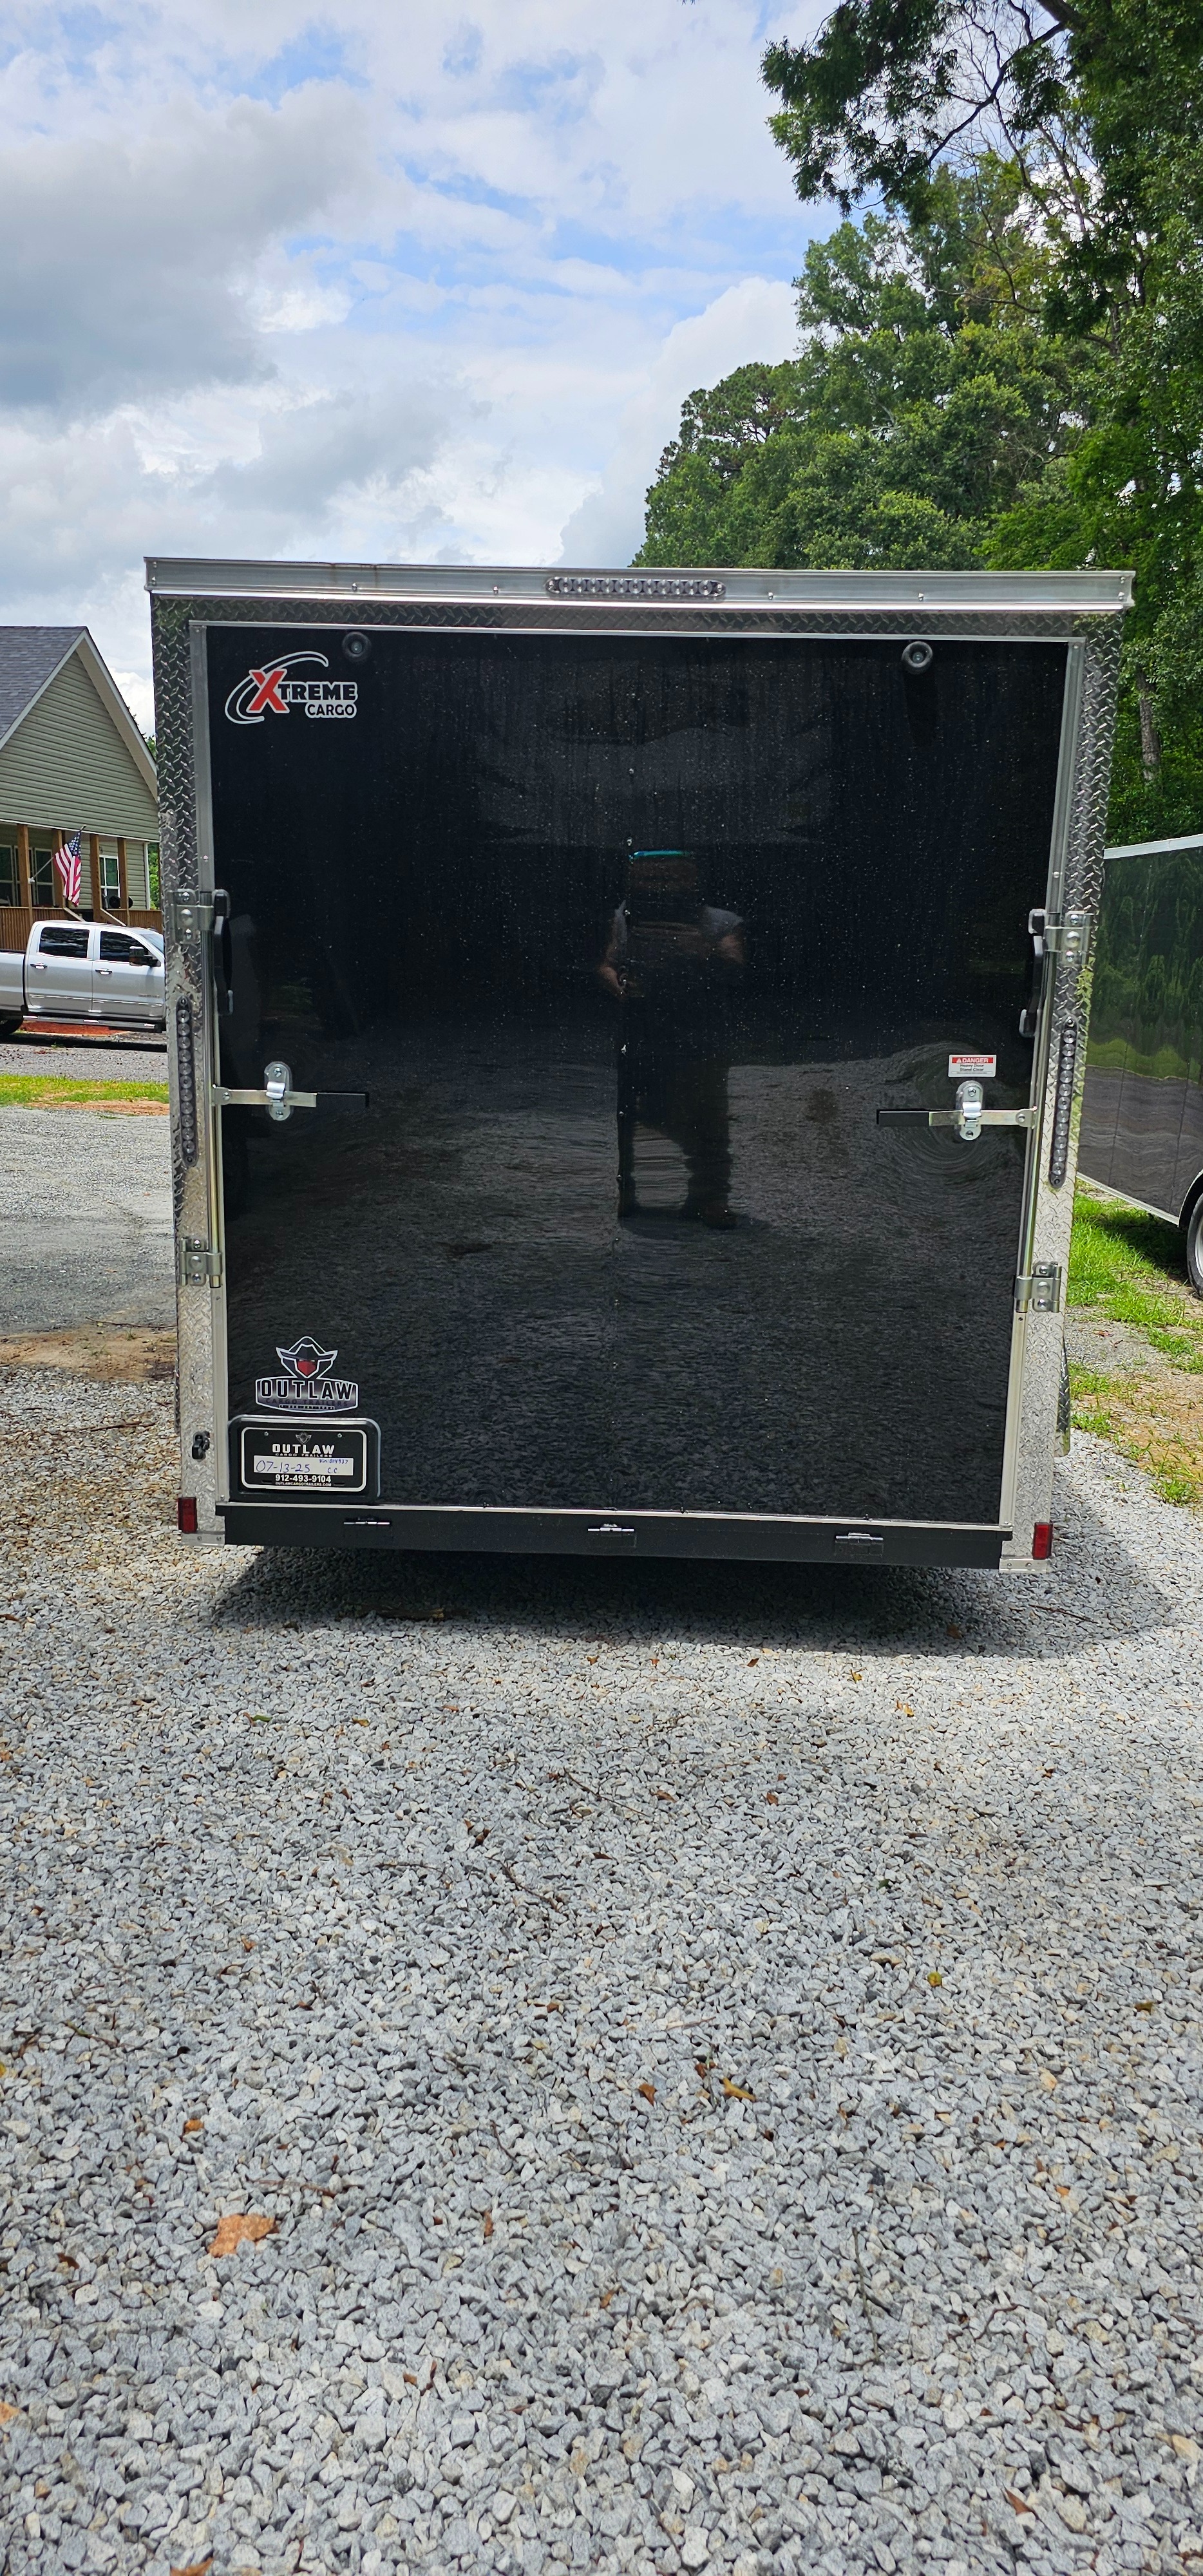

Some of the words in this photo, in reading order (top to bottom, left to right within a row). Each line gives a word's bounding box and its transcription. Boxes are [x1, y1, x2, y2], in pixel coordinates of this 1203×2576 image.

[247, 670, 357, 712] XTREME
[307, 704, 355, 716] CARGO
[260, 1379, 354, 1401] OUTLAW
[272, 1443, 335, 1454] OUTLAW
[256, 1460, 310, 1473] 07-13-25
[275, 1473, 332, 1483] 912-493-9104
